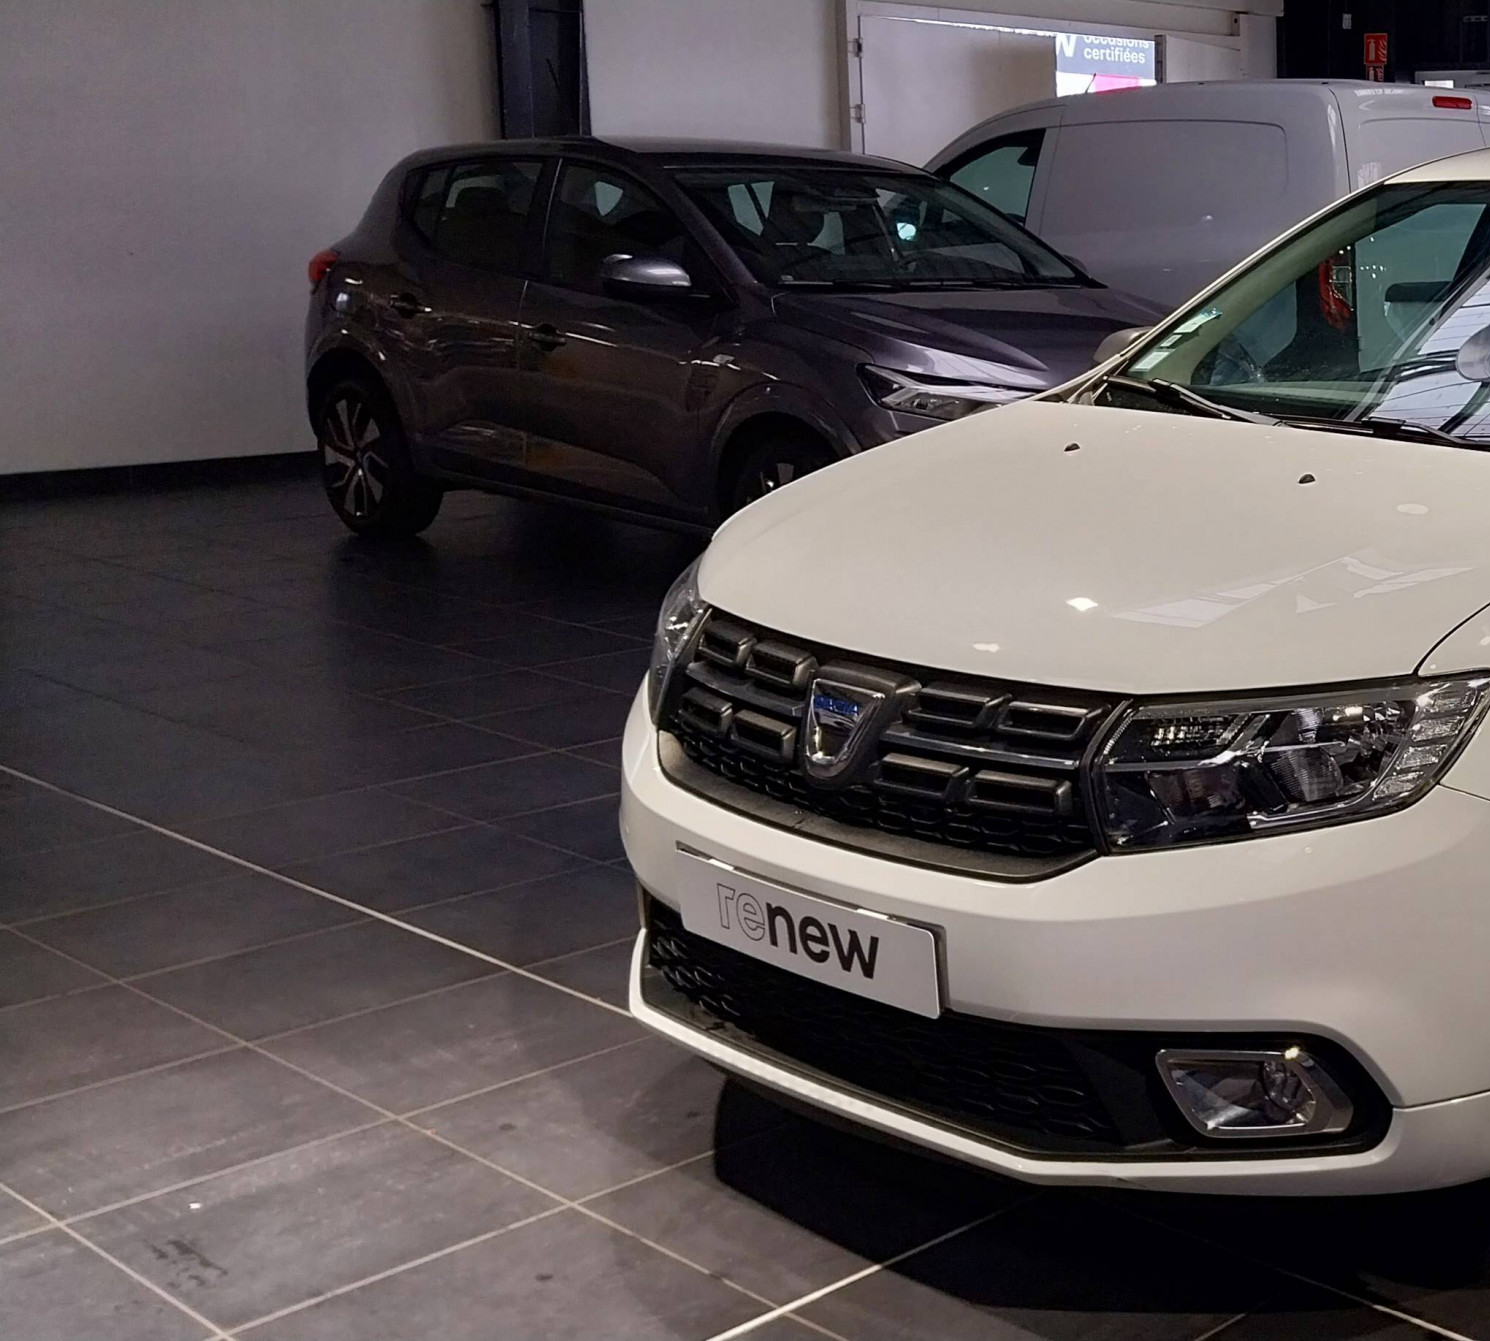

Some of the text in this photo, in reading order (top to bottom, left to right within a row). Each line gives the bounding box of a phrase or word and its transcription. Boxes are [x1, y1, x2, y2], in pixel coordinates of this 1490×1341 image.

[1083, 46, 1146, 64] certifiées
[814, 694, 860, 717] DACIA
[716, 882, 880, 980] renew
